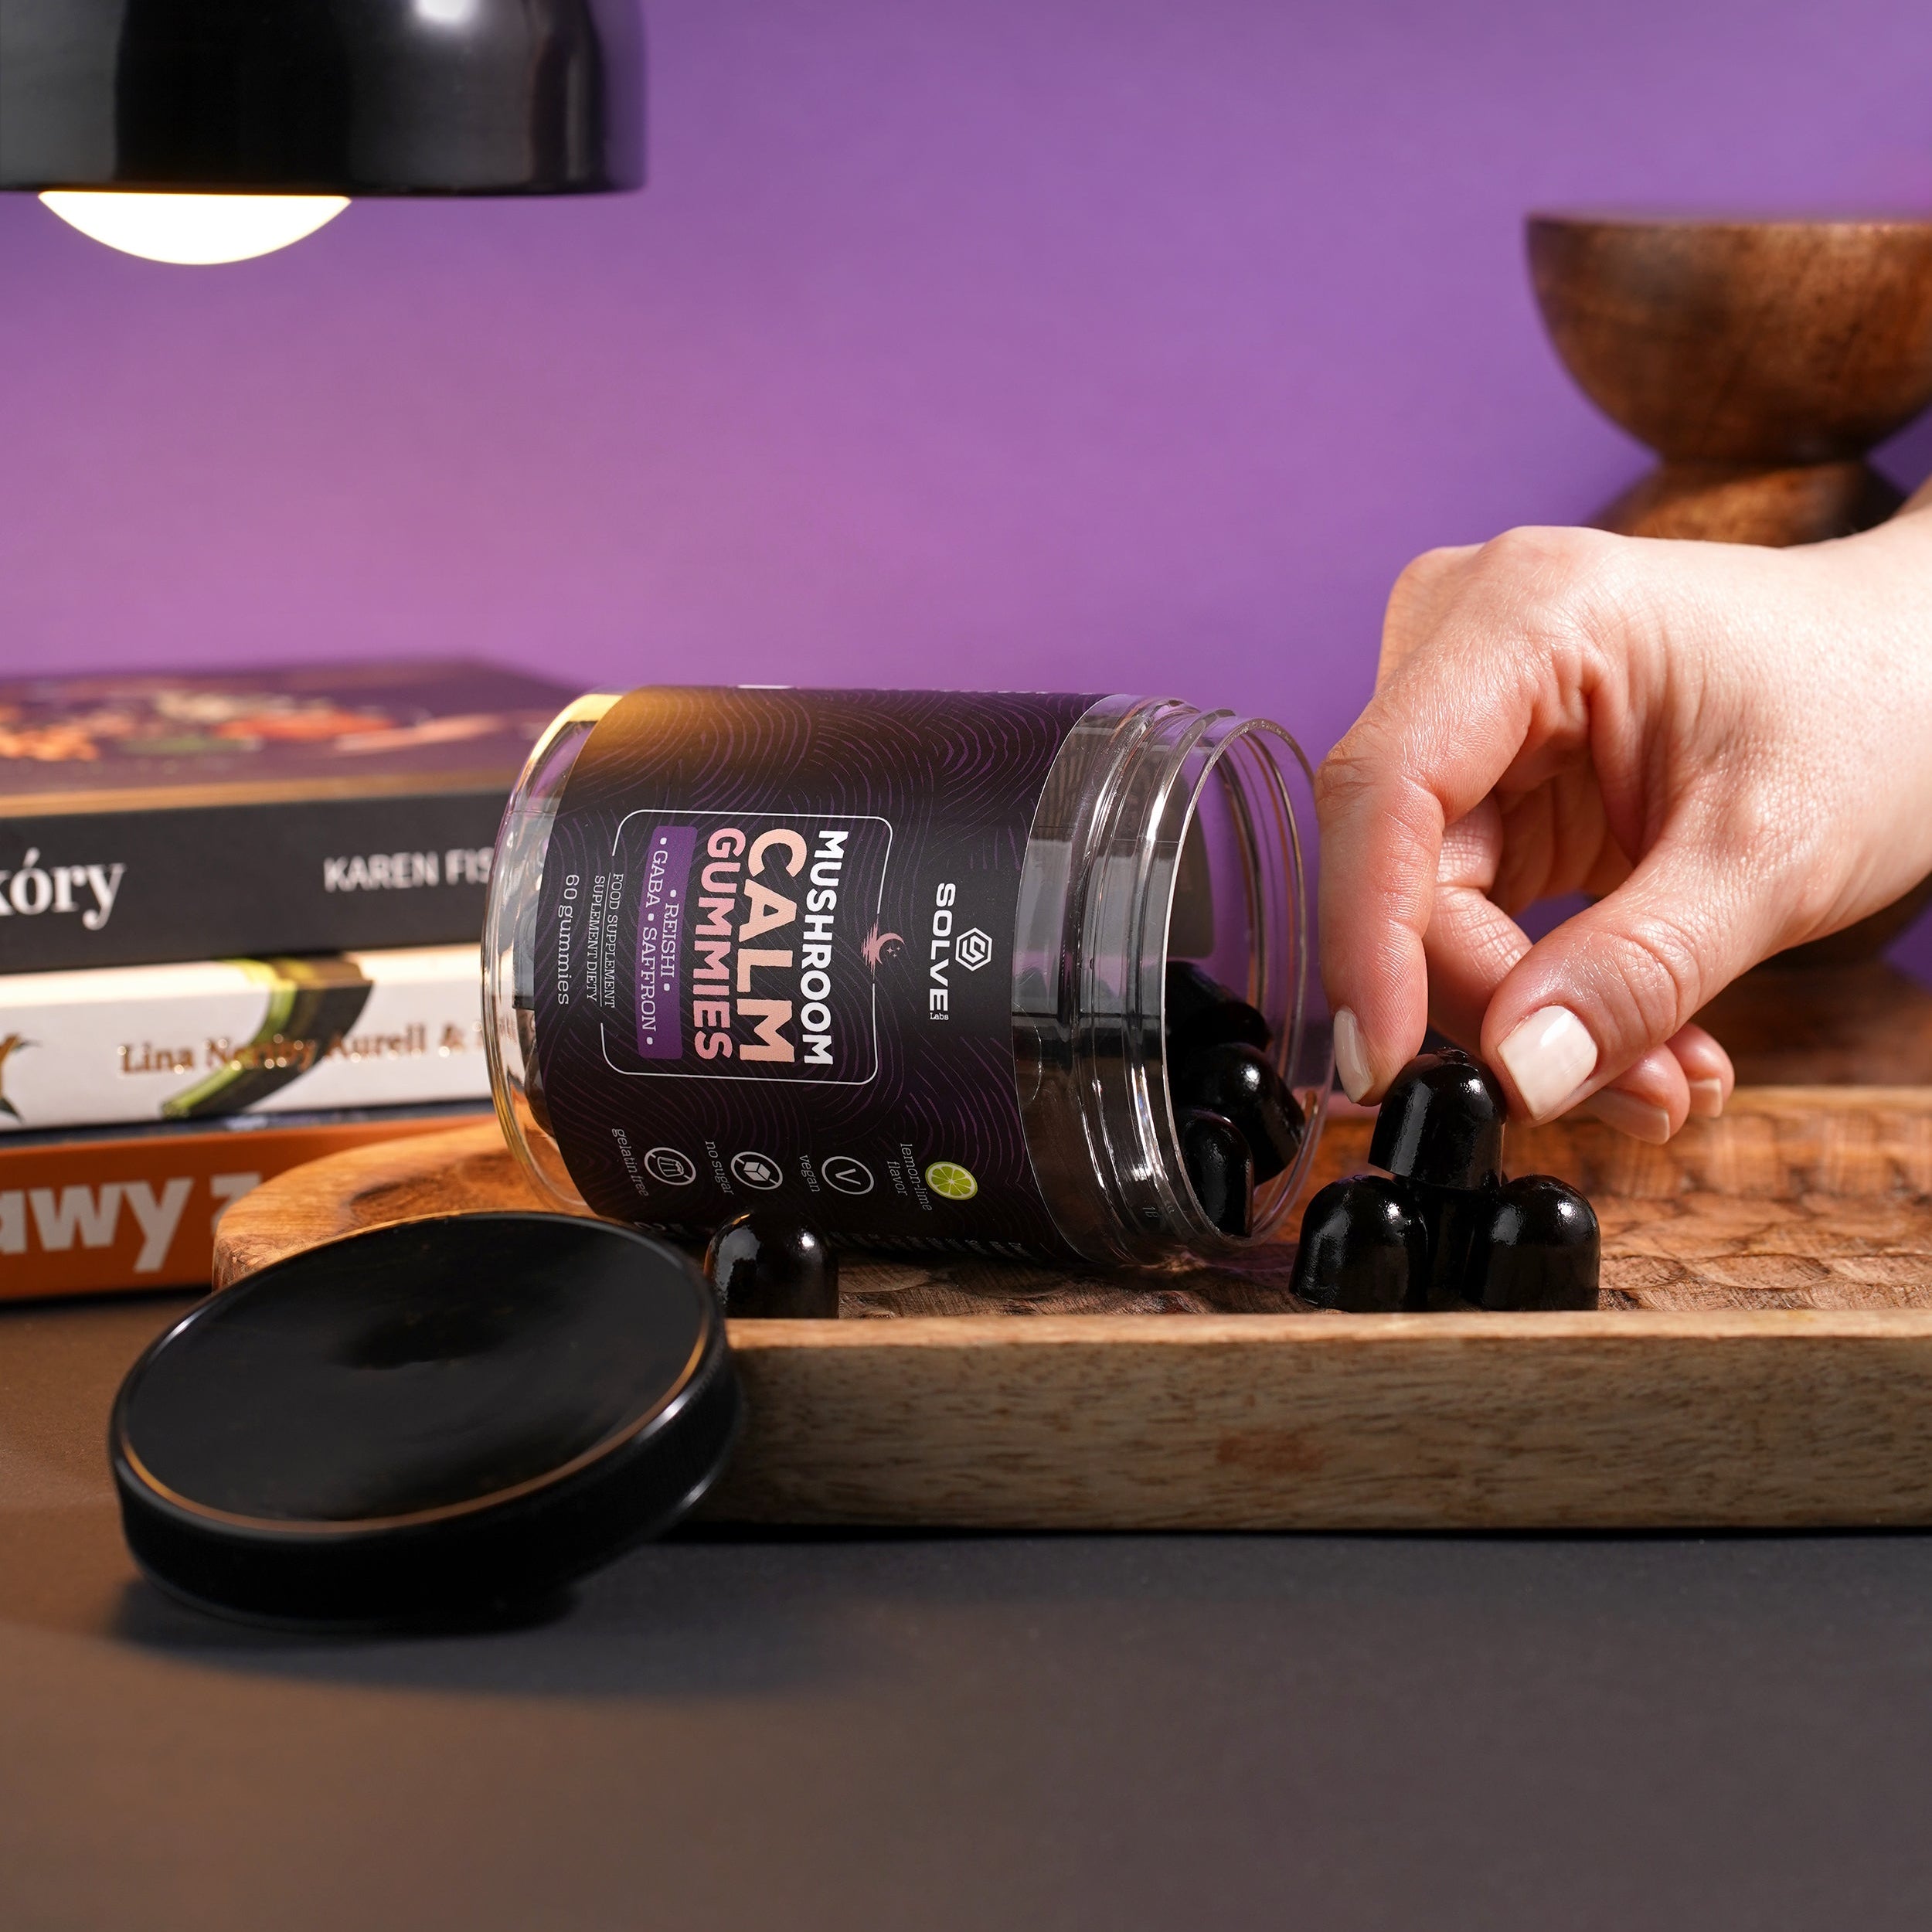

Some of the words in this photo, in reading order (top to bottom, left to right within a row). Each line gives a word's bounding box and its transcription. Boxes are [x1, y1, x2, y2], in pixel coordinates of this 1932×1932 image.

[0, 847, 126, 930] óry
[322, 851, 439, 893] KAREN
[563, 874, 580, 900] 60
[608, 873, 624, 910] FOOD
[645, 850, 668, 908] GABA
[588, 875, 606, 961] SUPLEMENT
[661, 903, 679, 978] REISHI
[692, 827, 747, 1060] GUMMIES
[736, 828, 808, 1063] CALM
[800, 830, 849, 1065] MUSHROOM
[929, 883, 956, 1012] SOLVE
[557, 905, 573, 1005] gummies
[586, 961, 598, 1002] DIETY
[604, 914, 619, 1008] SUPPLEMENT
[641, 927, 658, 1032] SAFFRON
[930, 1012, 949, 1021] Labs
[118, 1040, 193, 1074] Lina
[611, 1128, 638, 1175] gelatin
[630, 1174, 649, 1197] free
[705, 1140, 719, 1159] no
[712, 1160, 734, 1196] sugar
[798, 1155, 821, 1192] vegan
[886, 1160, 908, 1197] flavor
[900, 1142, 933, 1212] lemon-lime
